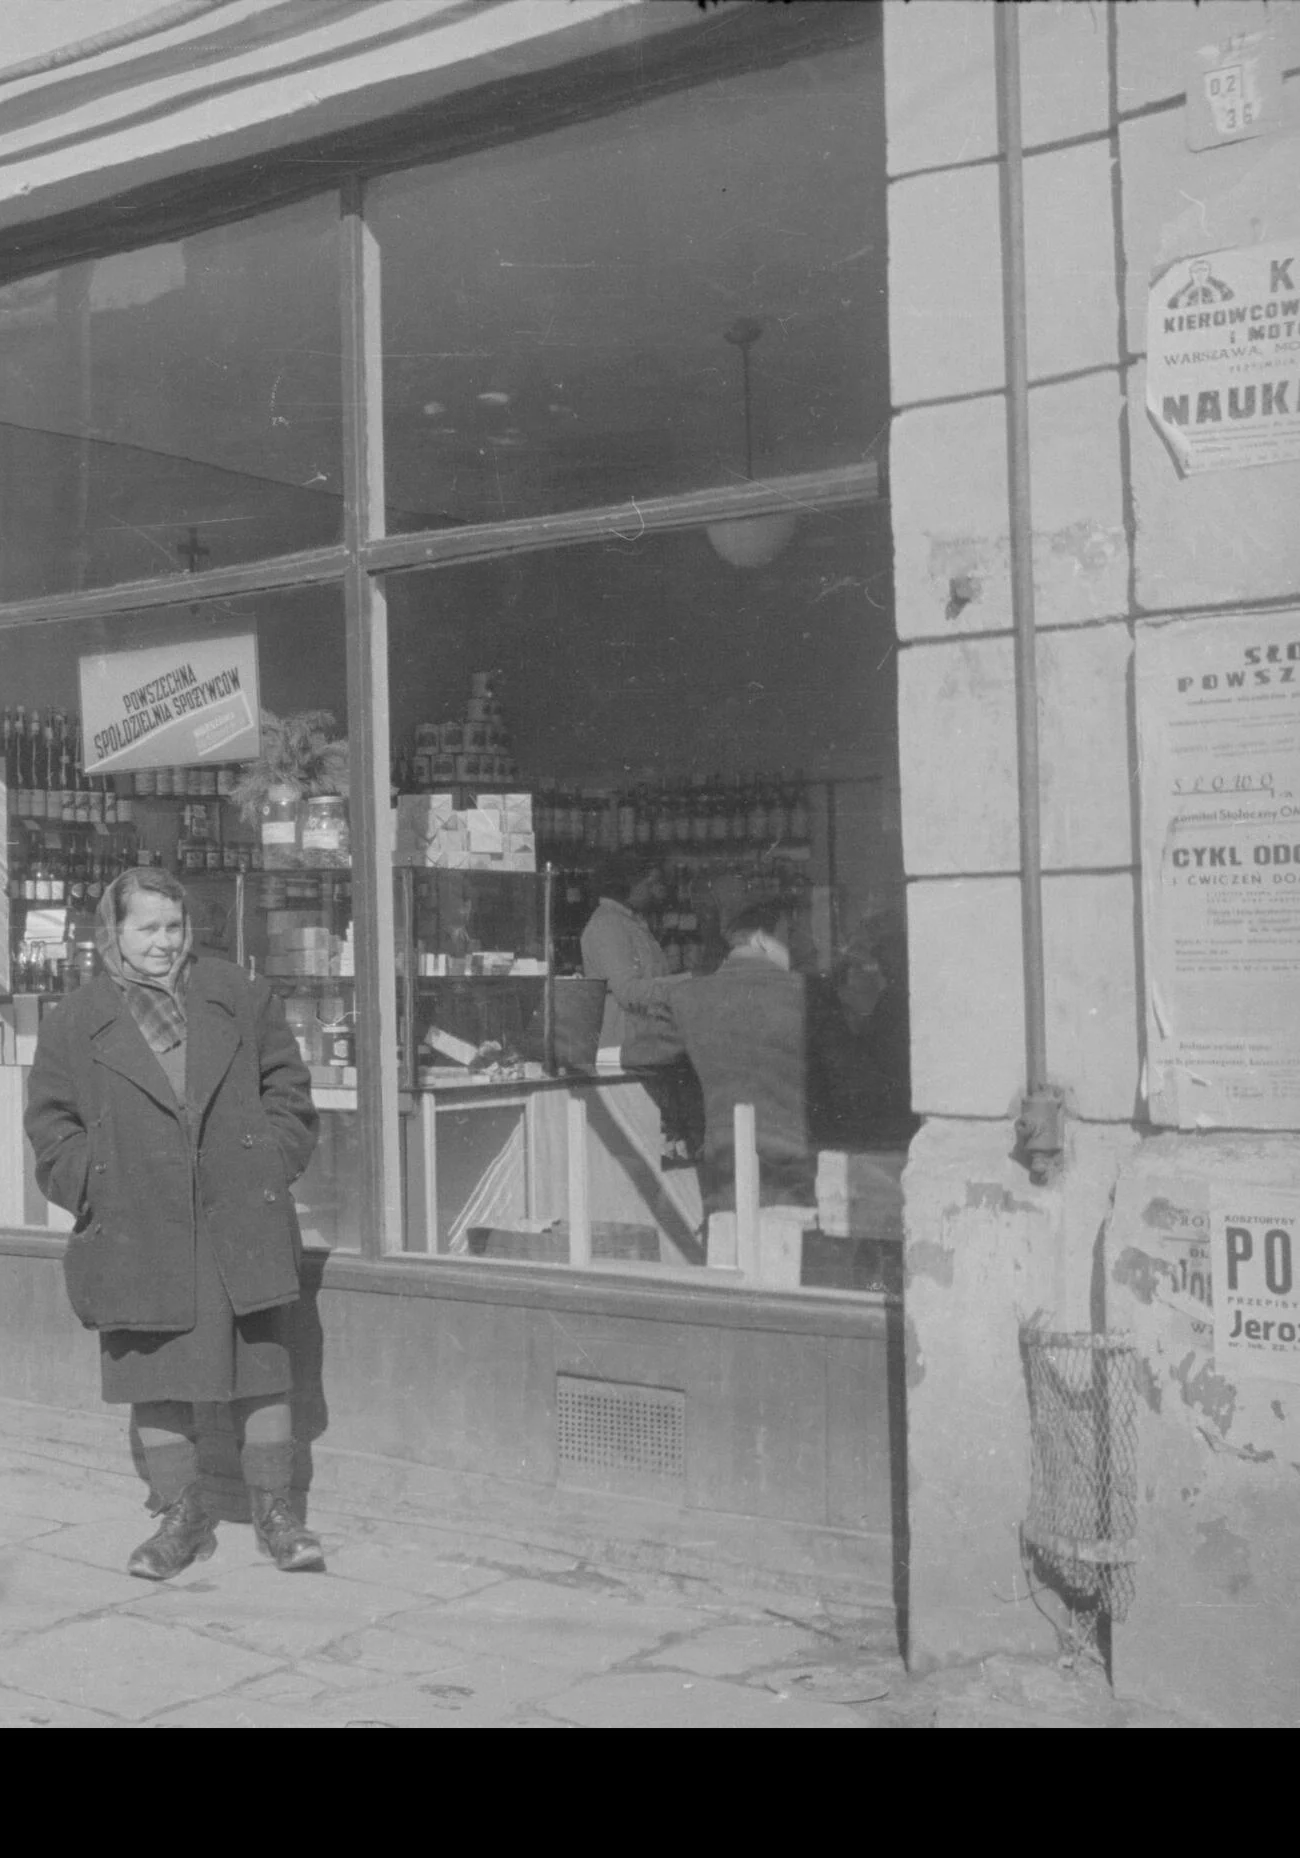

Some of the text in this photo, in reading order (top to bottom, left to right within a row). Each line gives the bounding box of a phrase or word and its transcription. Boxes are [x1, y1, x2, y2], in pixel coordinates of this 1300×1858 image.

[1247, 319, 1300, 342] MOT
[1162, 378, 1300, 427] NAUK
[123, 663, 198, 714] POWSZECHNA
[1172, 846, 1243, 869] CYKL
[1228, 1309, 1300, 1342] Jero
